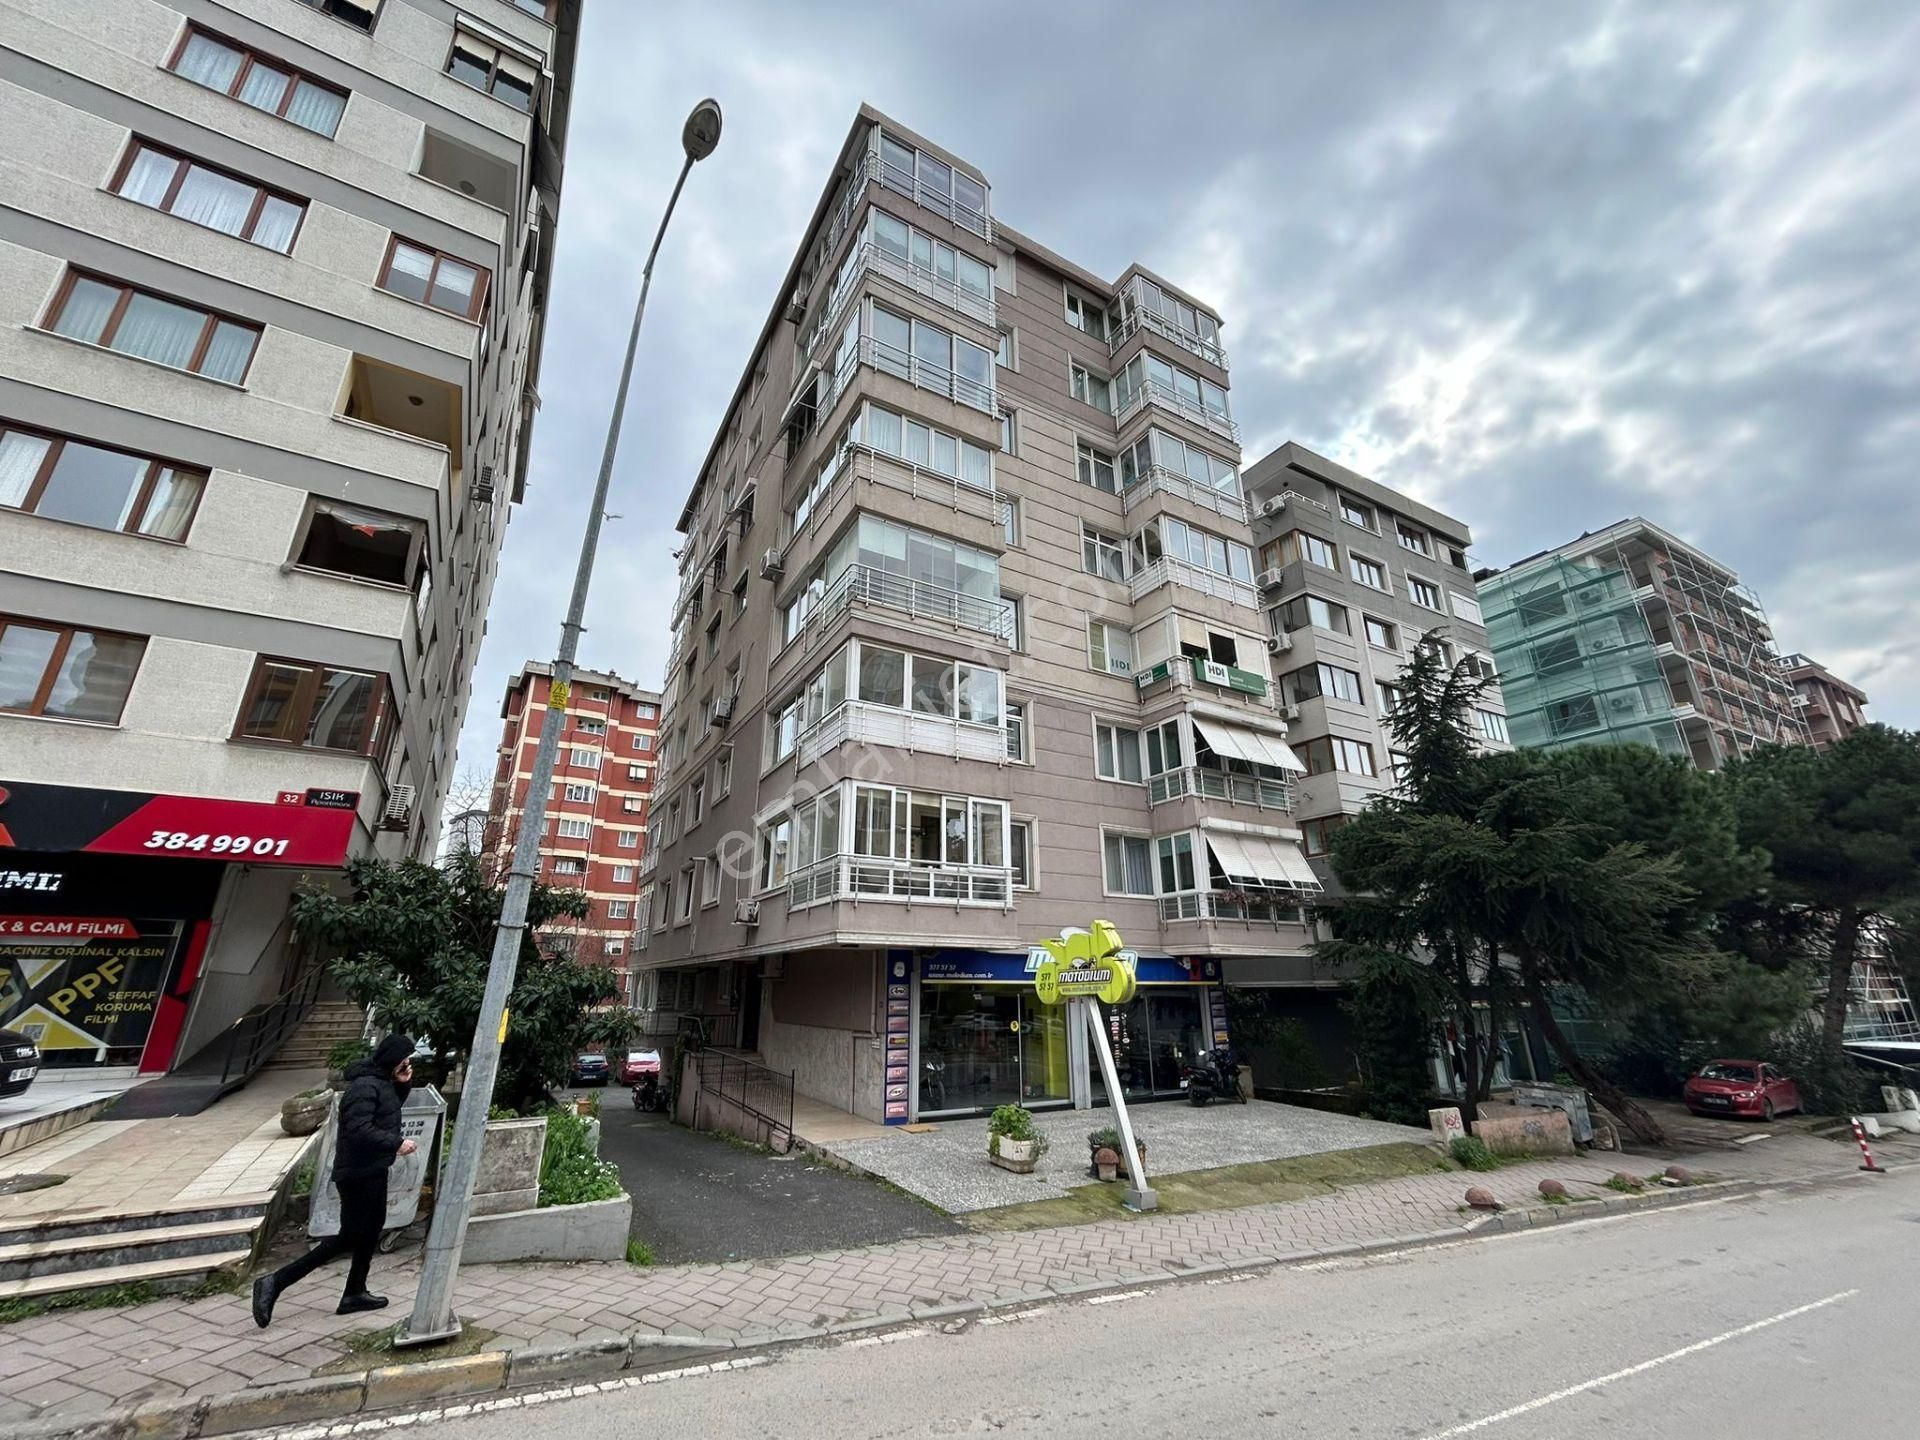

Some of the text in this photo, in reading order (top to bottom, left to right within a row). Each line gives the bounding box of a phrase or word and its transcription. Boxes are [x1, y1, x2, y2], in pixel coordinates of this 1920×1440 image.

[1208, 664, 1225, 677] HDI
[283, 793, 299, 803] 32
[143, 830, 290, 856] 384 99 01
[29, 921, 74, 933] CAM
[1041, 972, 1052, 982] 577
[47, 957, 126, 1016] PPF
[94, 1002, 152, 1012] KORUMA
